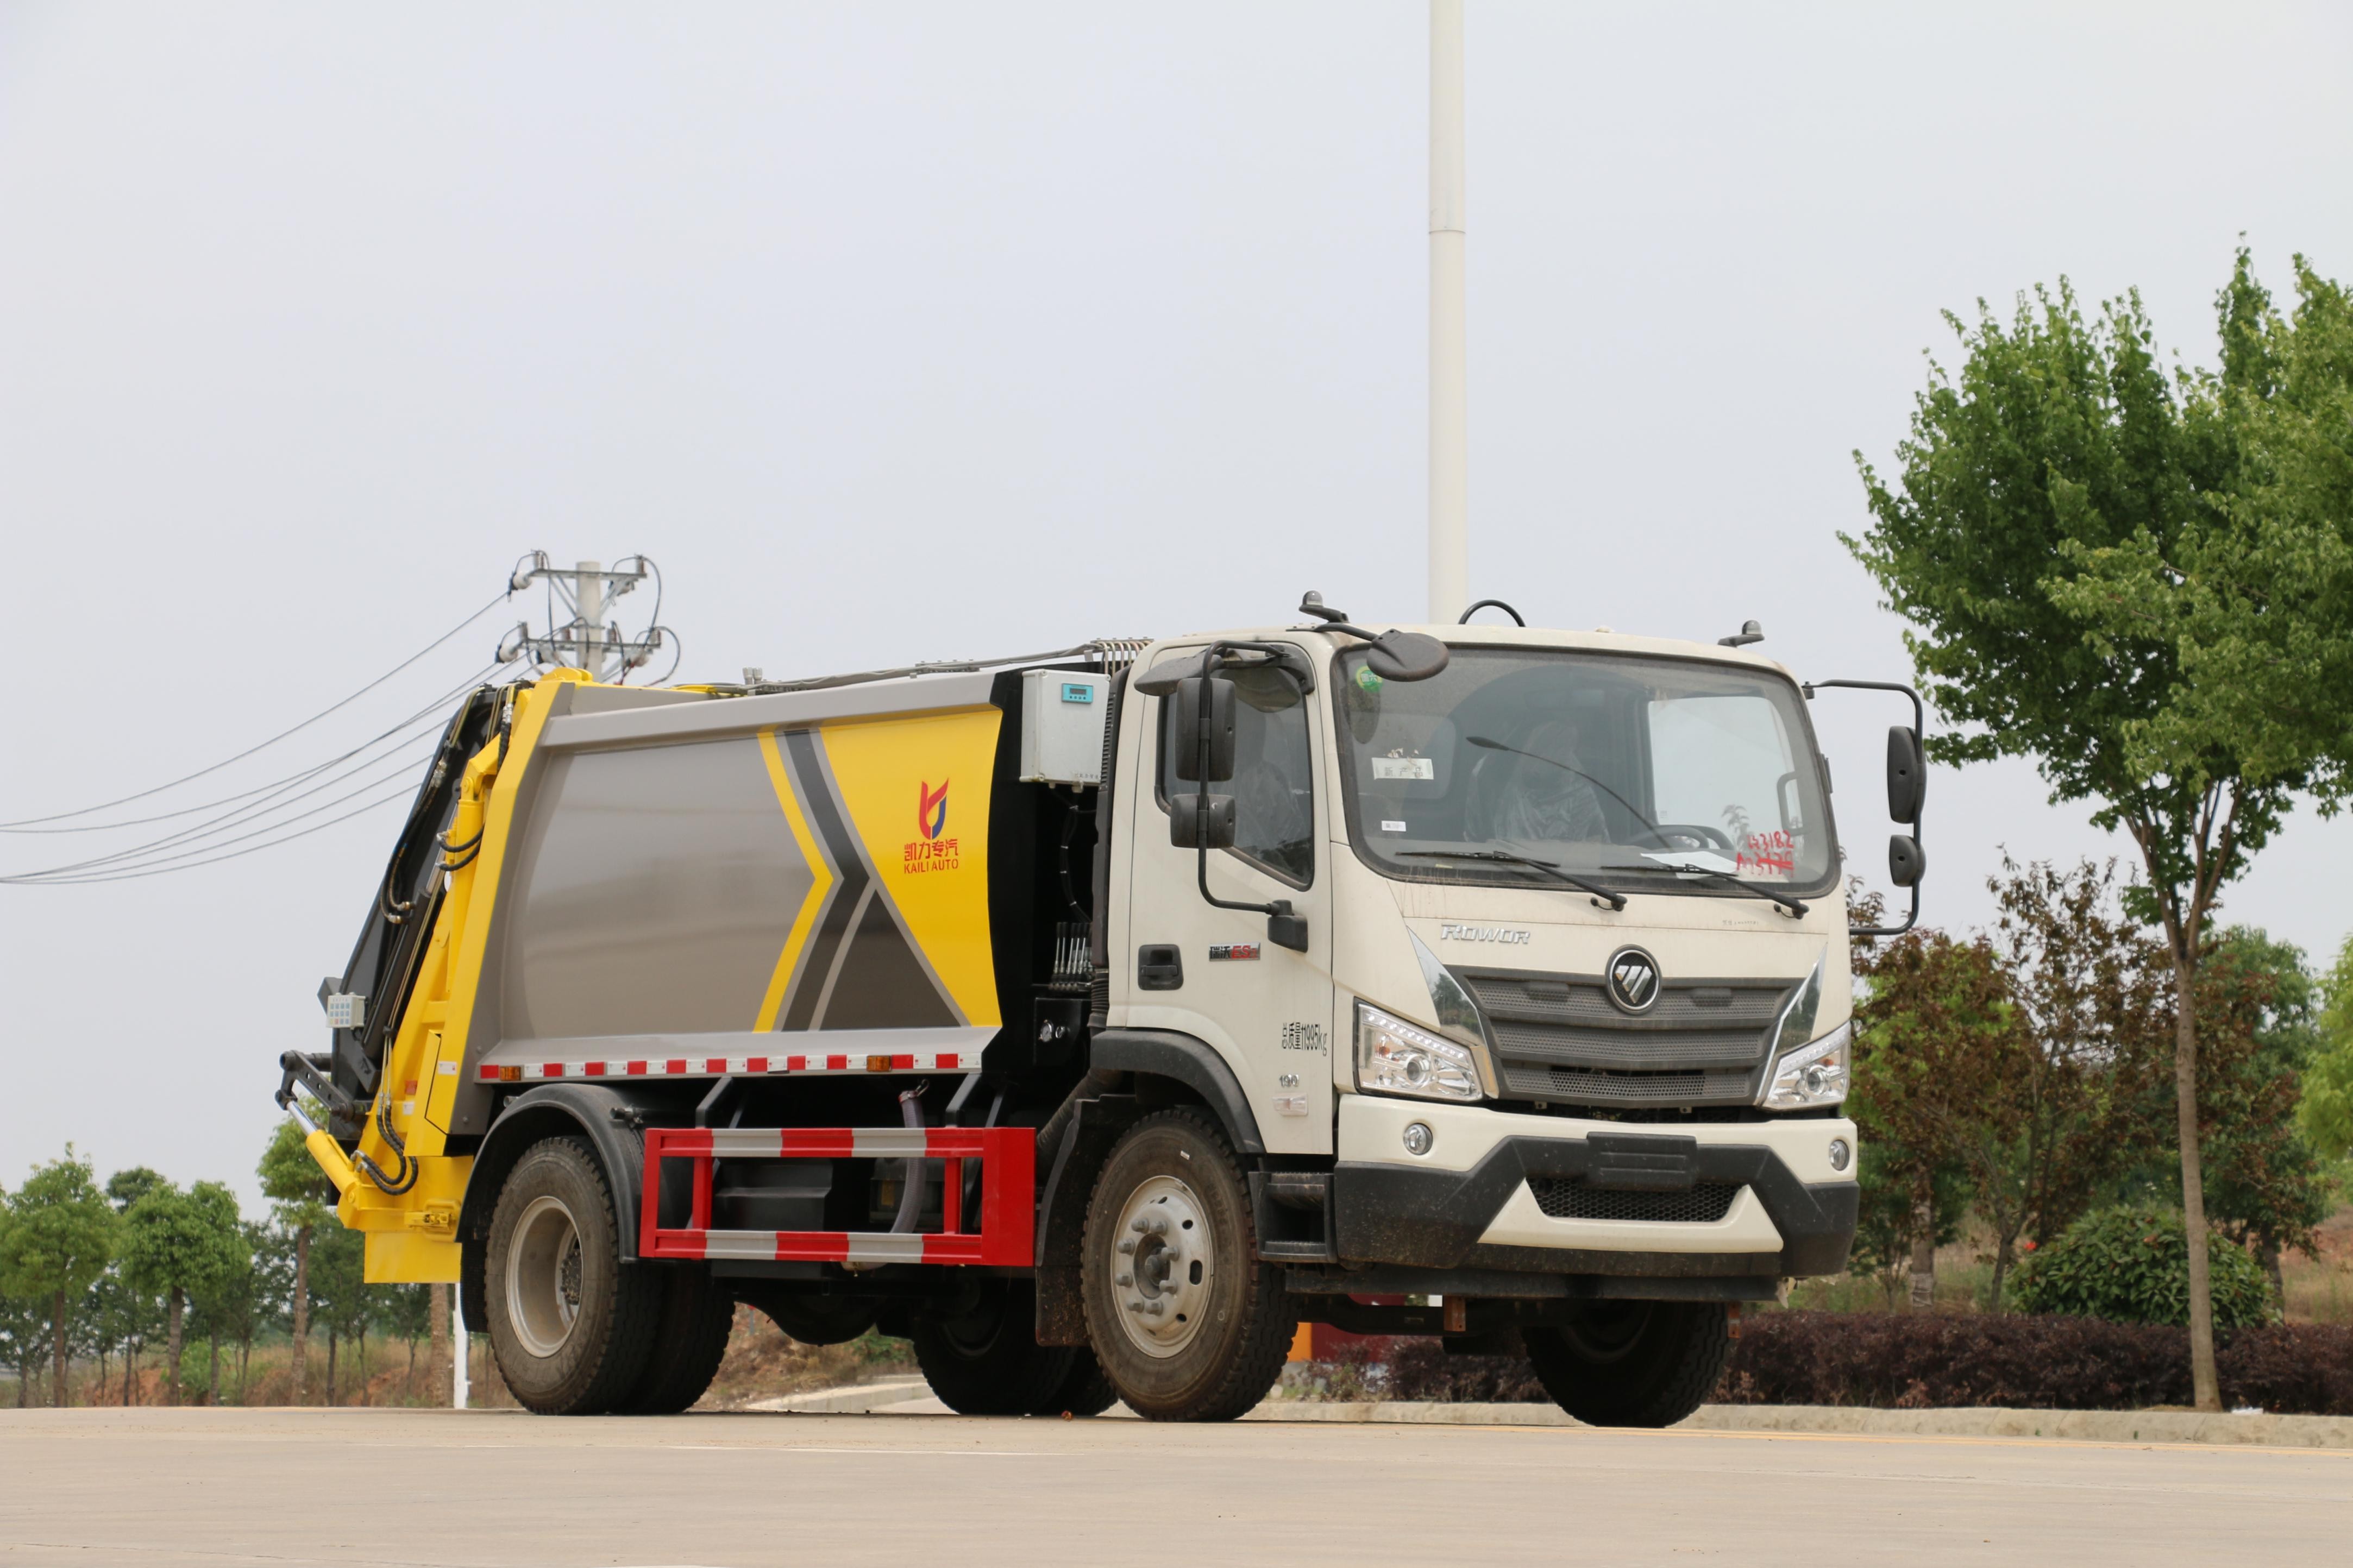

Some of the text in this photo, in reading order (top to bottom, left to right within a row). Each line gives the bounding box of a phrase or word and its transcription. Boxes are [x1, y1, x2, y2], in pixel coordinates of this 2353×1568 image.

[904, 839, 959, 861] 凯力专汽
[904, 859, 958, 874] KAILI AUTO
[1441, 924, 1530, 944] ROWOR
[1282, 1022, 1327, 1056] 总质量11995kg
[1279, 1074, 1299, 1087] 190
